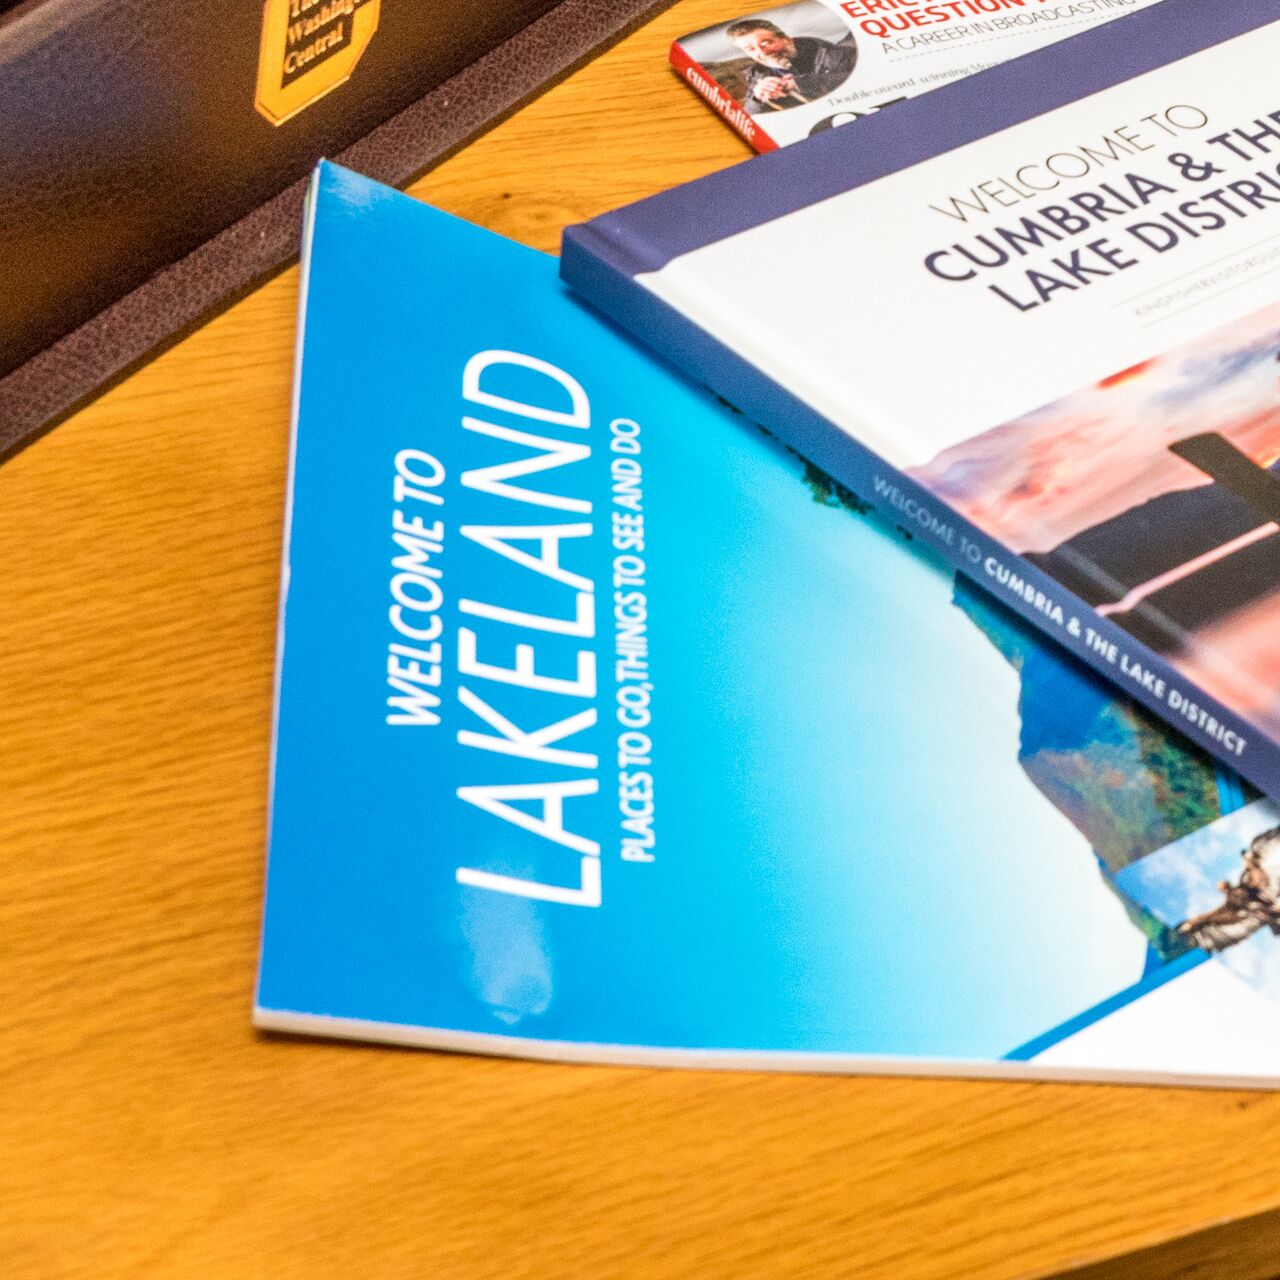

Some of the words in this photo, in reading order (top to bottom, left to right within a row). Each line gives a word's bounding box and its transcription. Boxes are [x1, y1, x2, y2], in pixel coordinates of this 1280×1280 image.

[285, 22, 343, 74] Central
[881, 42, 896, 54] A
[896, 25, 970, 51] CAREER
[970, 21, 995, 35] IN
[686, 66, 756, 141] cumbrialife
[929, 126, 1156, 224] WELCOME
[1140, 103, 1208, 138] TO
[924, 171, 1178, 282] CUMBRIA
[1167, 151, 1228, 182] &
[987, 237, 1139, 313] LAKE
[609, 417, 642, 455] DO
[393, 448, 446, 506] TO
[610, 458, 643, 511] AND
[611, 511, 645, 552] SEE
[612, 554, 646, 588] TO
[385, 511, 445, 726] WELCOME
[455, 348, 602, 908] LAKELAND
[871, 473, 957, 546] WELCOME
[959, 538, 983, 565] TO
[984, 556, 1064, 623] CUMBRIA
[1067, 615, 1082, 639] &
[1085, 627, 1118, 663] THE
[1120, 654, 1166, 699] LAKE
[1168, 689, 1248, 758] DISTRICT
[617, 731, 652, 769] TO
[618, 770, 656, 863] PLACES
